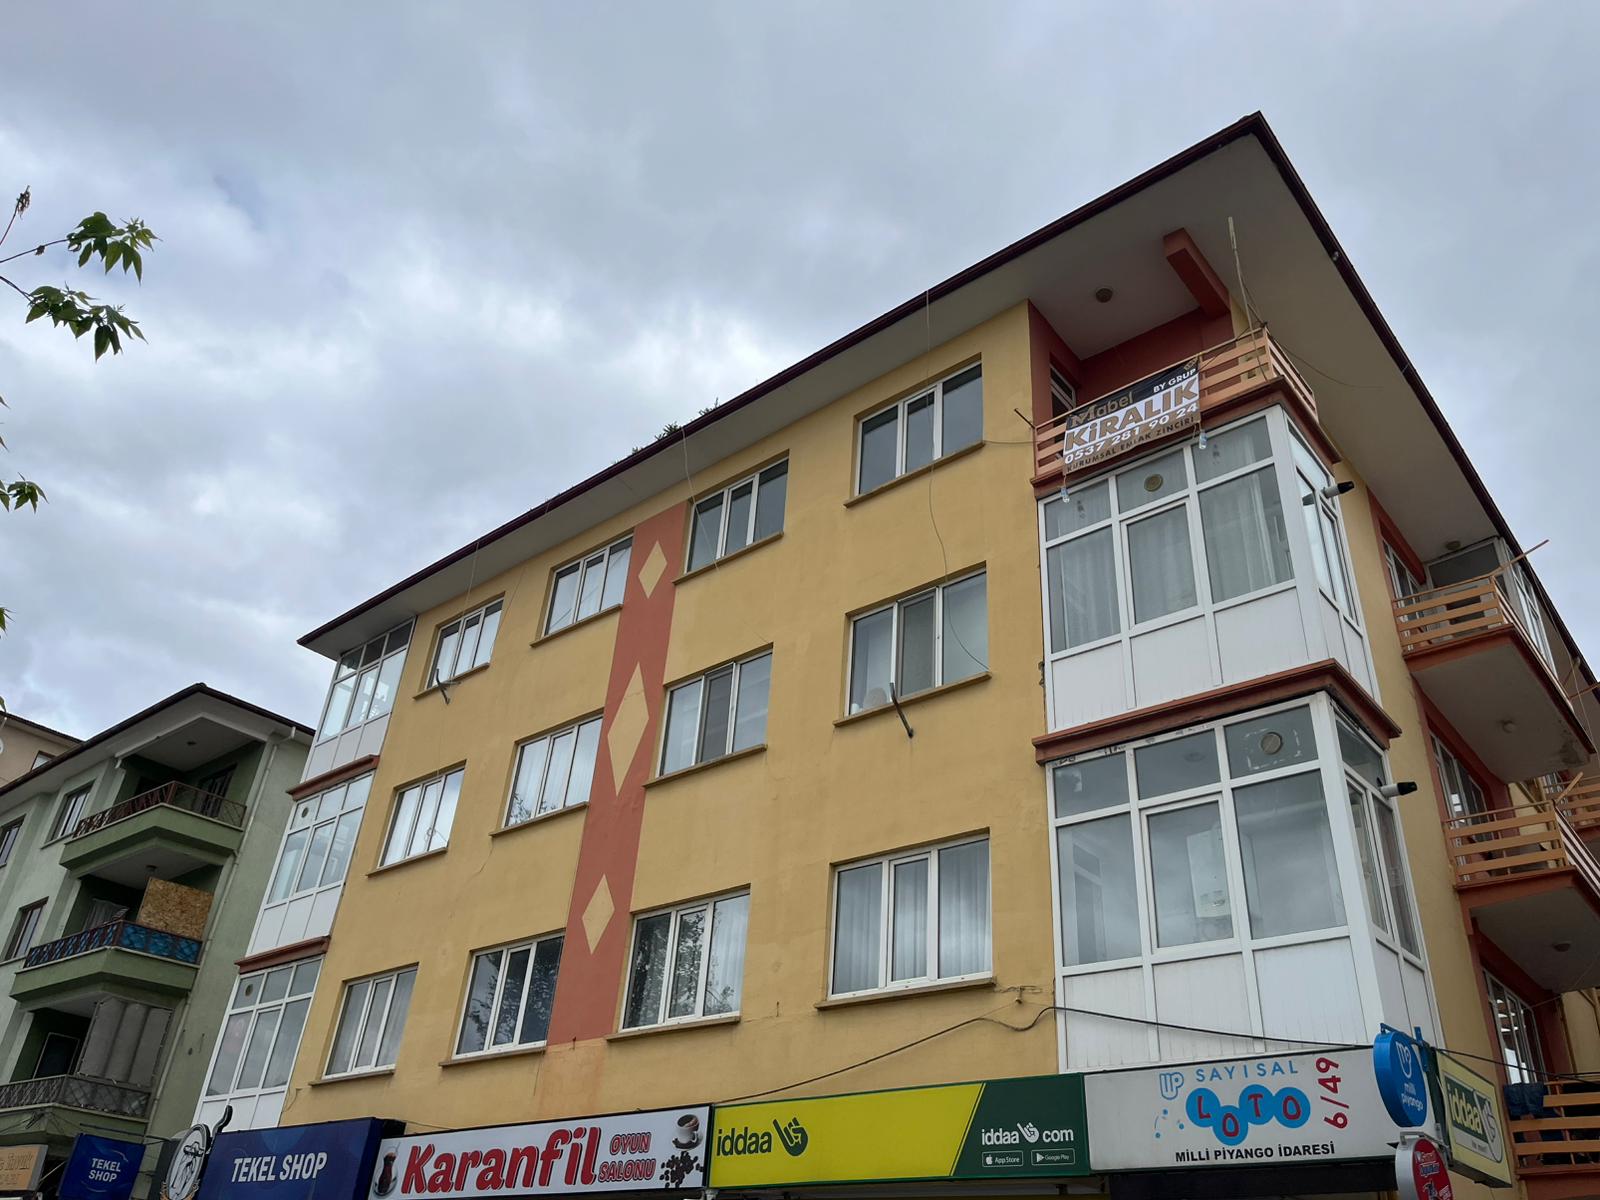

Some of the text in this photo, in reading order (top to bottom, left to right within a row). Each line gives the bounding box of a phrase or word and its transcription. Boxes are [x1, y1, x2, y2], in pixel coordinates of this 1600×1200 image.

[1153, 368, 1196, 393] BY GRUP
[1071, 391, 1133, 427] Mabel
[1065, 402, 1198, 464] 0537 281 90 24
[1067, 448, 1116, 473] KURUMSAL
[1196, 1060, 1298, 1083] SAYISAL
[1315, 1056, 1350, 1129] 6/49
[1197, 1093, 1301, 1138] LOTO
[1448, 1083, 1483, 1135] iddaa
[610, 1132, 652, 1155] OYUN
[716, 1127, 772, 1157] iddaa
[981, 1128, 1020, 1145] iddaa
[401, 1126, 601, 1195] Karanfil
[1175, 1140, 1335, 1163] MİLLİ PİYANGO İDARESİ
[88, 1170, 118, 1182] SHOP
[91, 1158, 121, 1172] TEKEL
[231, 1152, 328, 1183] TEKEL SHOP
[598, 1158, 656, 1183] SALONU
